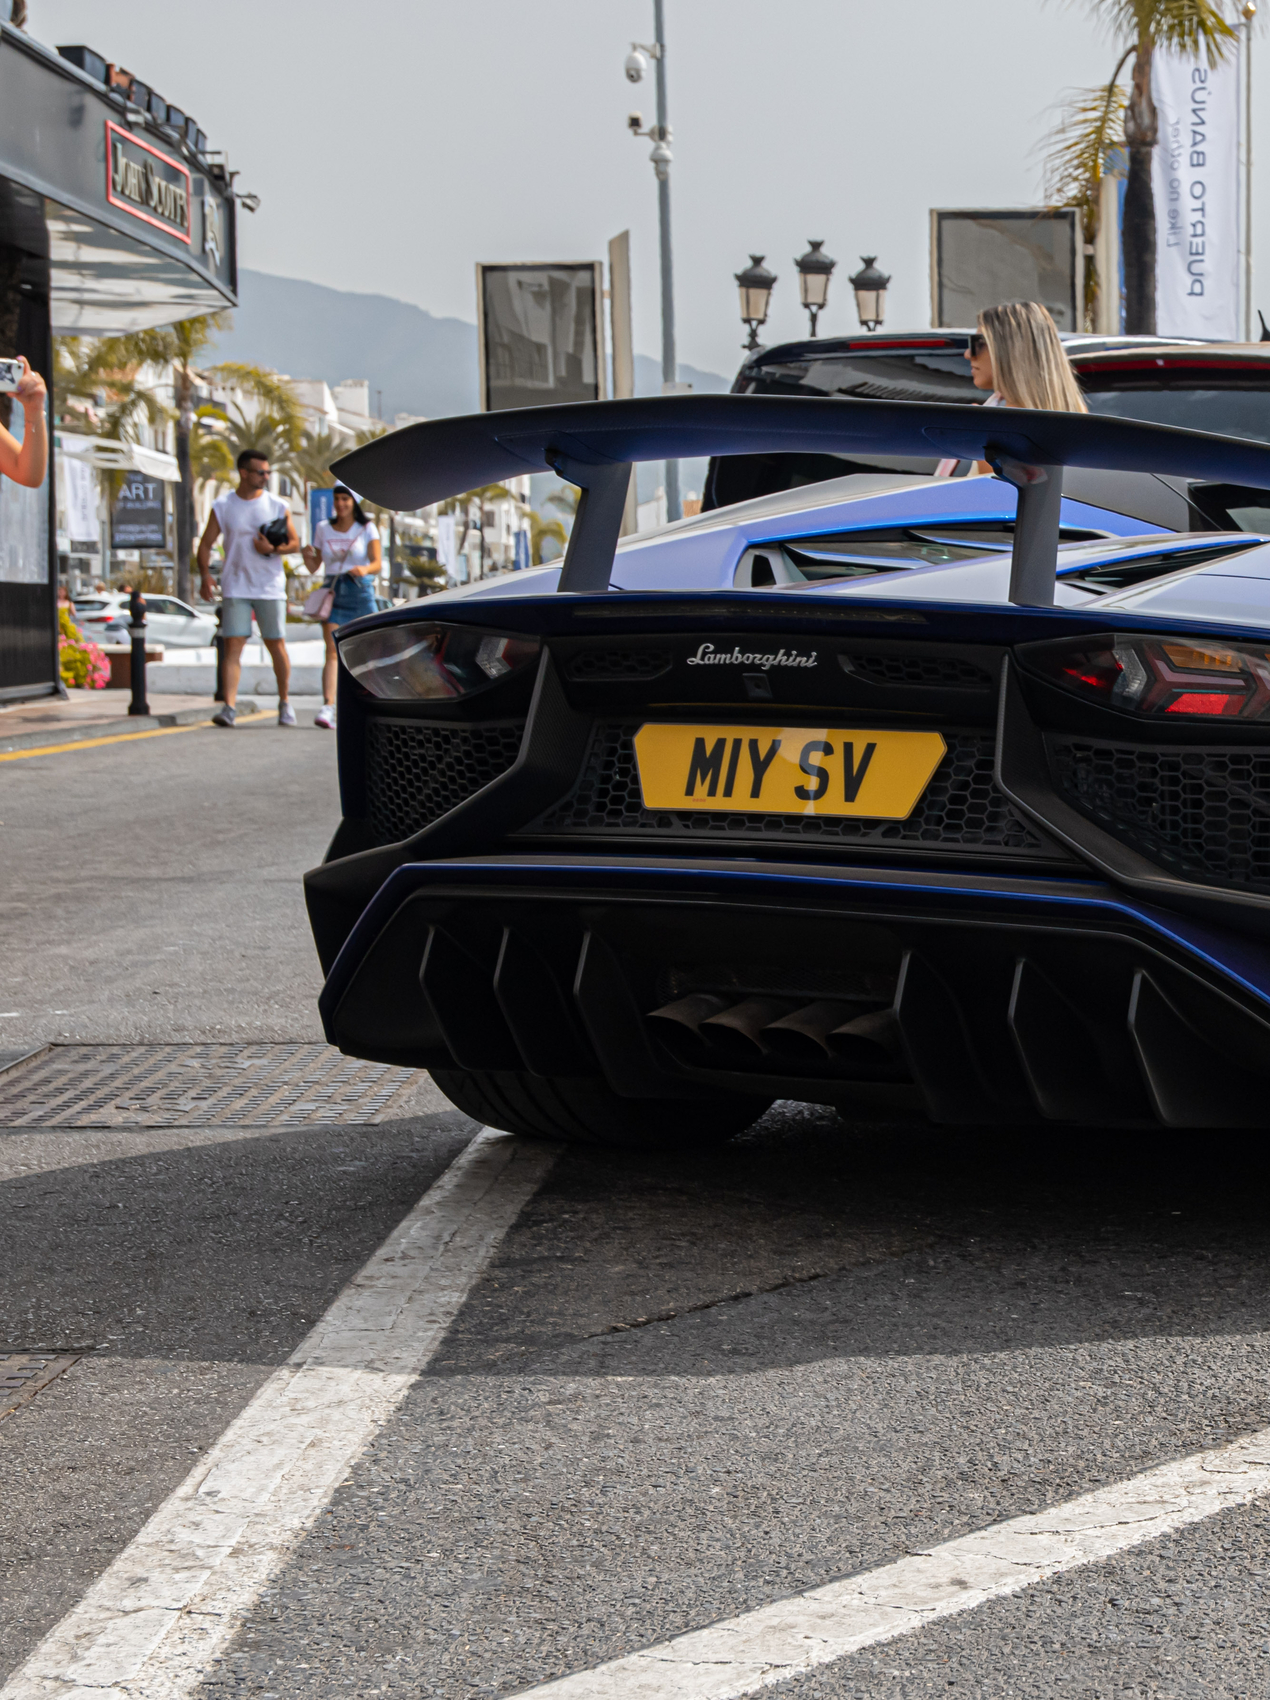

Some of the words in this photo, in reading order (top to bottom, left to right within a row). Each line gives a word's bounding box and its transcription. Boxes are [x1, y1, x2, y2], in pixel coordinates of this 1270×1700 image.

[118, 482, 157, 499] ART
[686, 643, 818, 670] Lamborghini
[794, 740, 877, 803] SV
